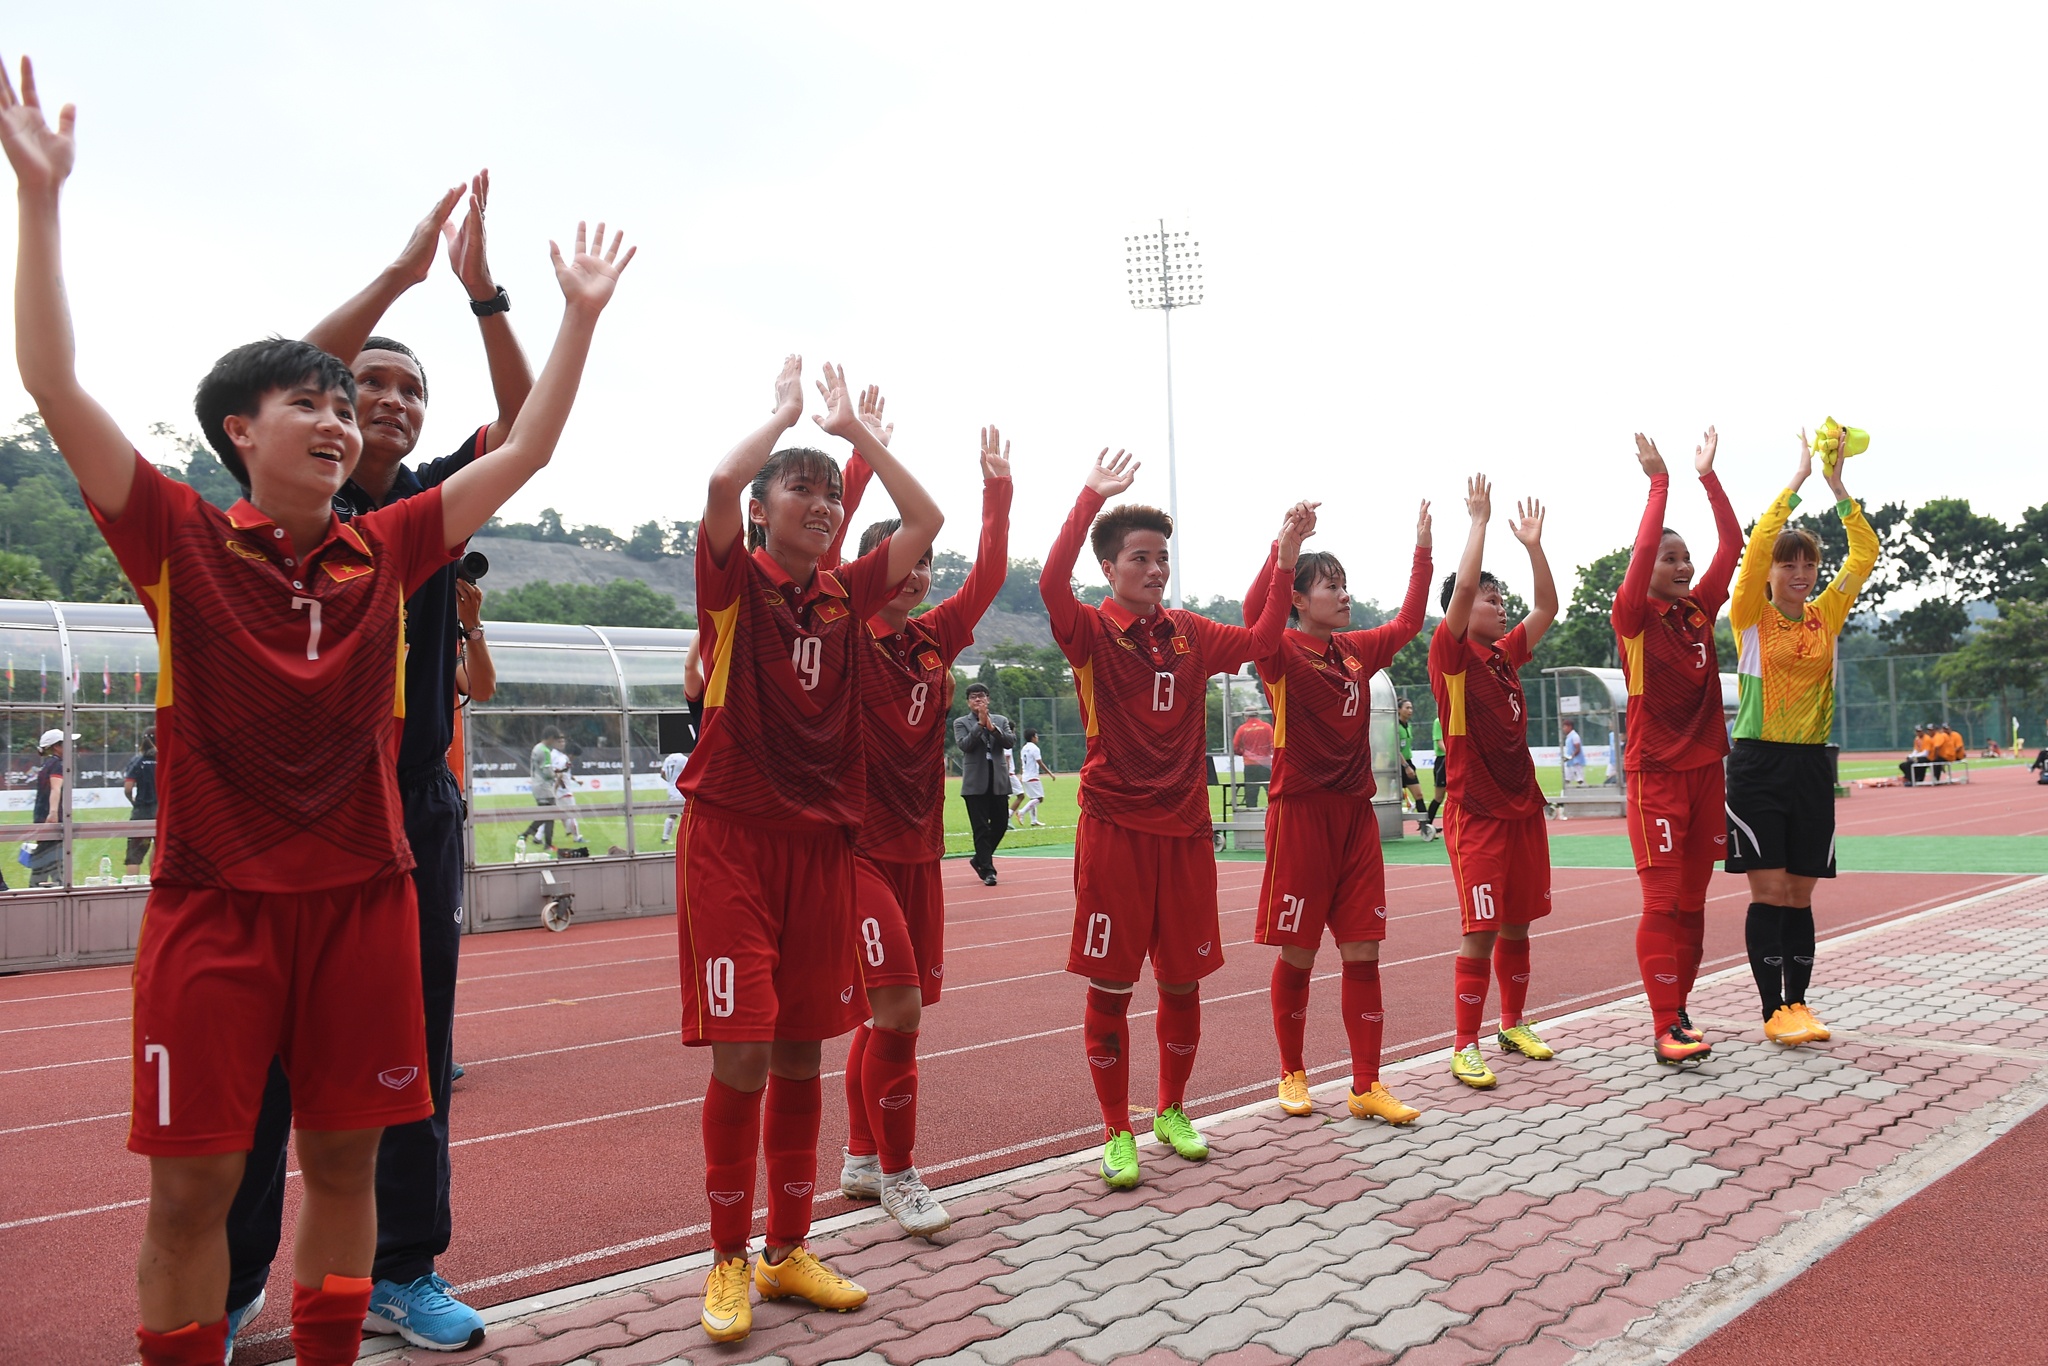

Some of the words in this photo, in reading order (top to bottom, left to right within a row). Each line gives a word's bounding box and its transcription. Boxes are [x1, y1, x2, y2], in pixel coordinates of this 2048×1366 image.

[291, 596, 322, 661] 7
[792, 637, 822, 691] 19
[1692, 642, 1707, 669] 3
[907, 682, 928, 726] 8
[1152, 672, 1175, 711] 13
[1342, 680, 1360, 717] 21
[597, 761, 611, 769] SEA
[1655, 818, 1673, 853] 3
[1730, 828, 1742, 858] 1
[1277, 893, 1305, 934] 21
[1472, 883, 1495, 921] 16
[861, 917, 885, 967] 8
[1083, 912, 1112, 959] 13
[705, 956, 735, 1018] 19
[145, 1043, 171, 1126] 7
